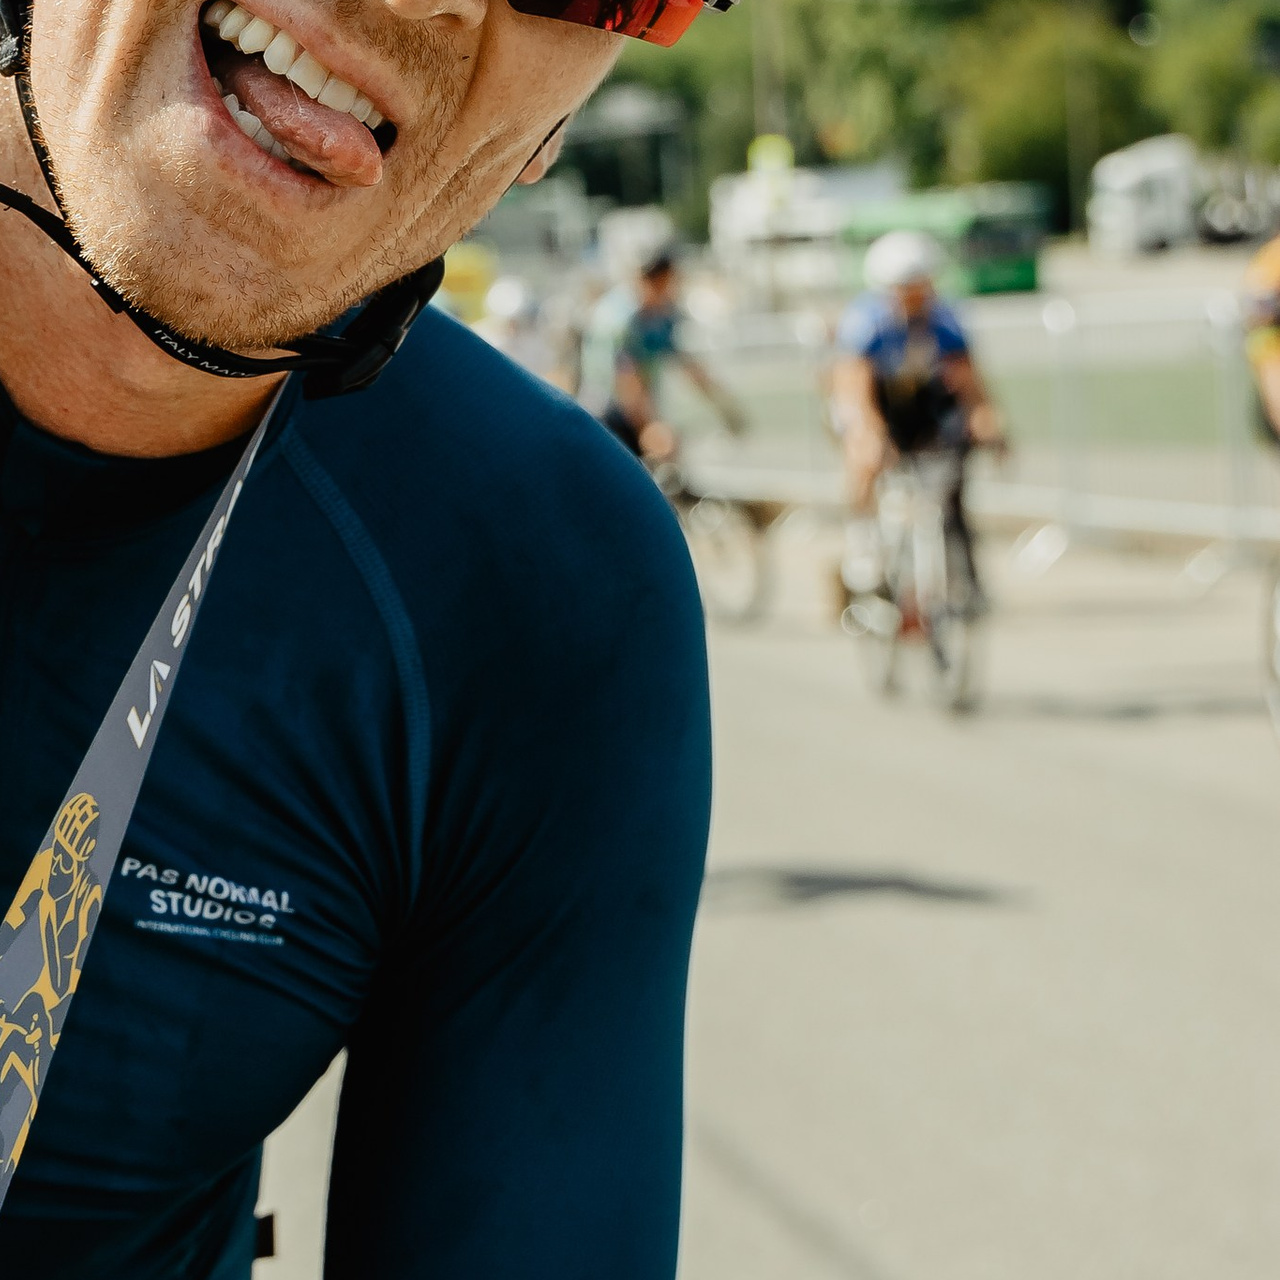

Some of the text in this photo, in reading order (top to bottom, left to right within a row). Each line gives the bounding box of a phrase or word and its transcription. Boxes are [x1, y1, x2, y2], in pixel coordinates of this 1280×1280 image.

[154, 329, 200, 359] ITALY
[127, 660, 171, 750] LA
[121, 857, 180, 885] PAS
